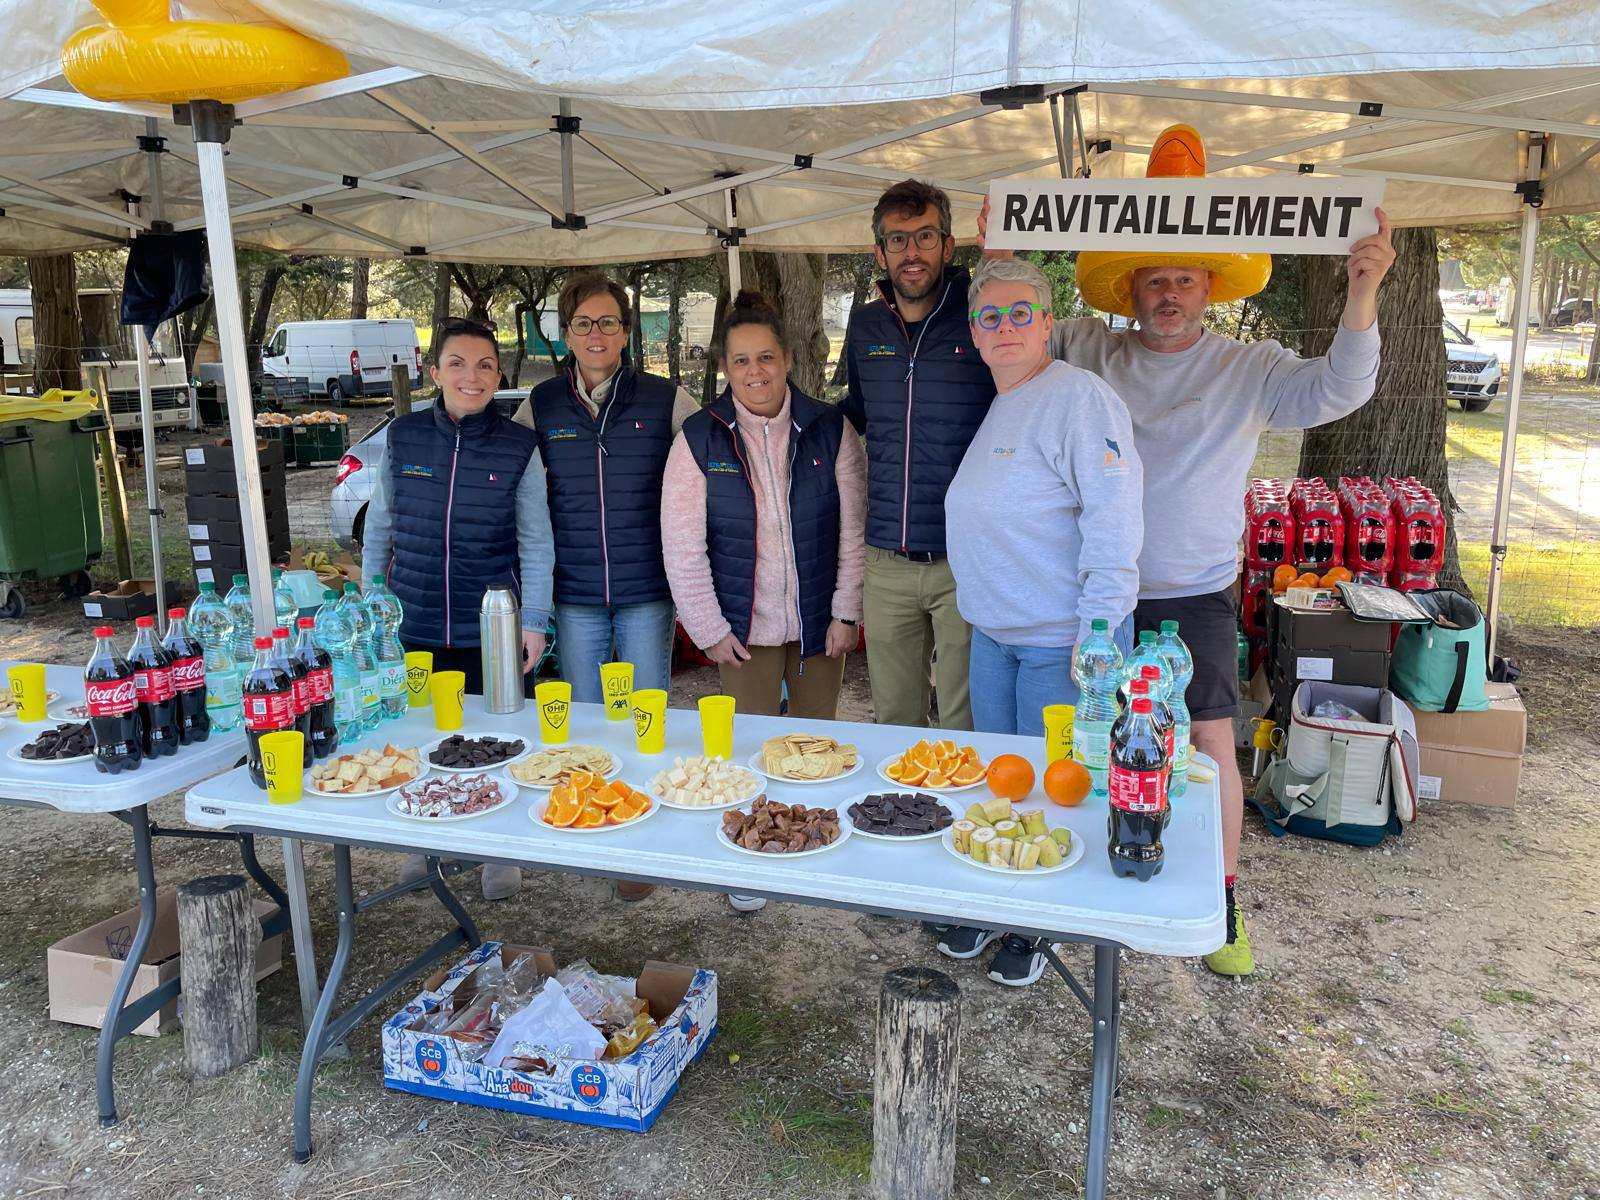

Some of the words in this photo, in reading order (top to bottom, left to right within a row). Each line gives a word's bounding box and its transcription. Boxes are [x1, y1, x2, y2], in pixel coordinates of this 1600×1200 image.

[1003, 193, 1363, 238] RAVITAILLEMENT
[607, 676, 630, 693] 40
[610, 699, 628, 709] AXA
[420, 1046, 442, 1059] SCB
[577, 1073, 602, 1084] SCB
